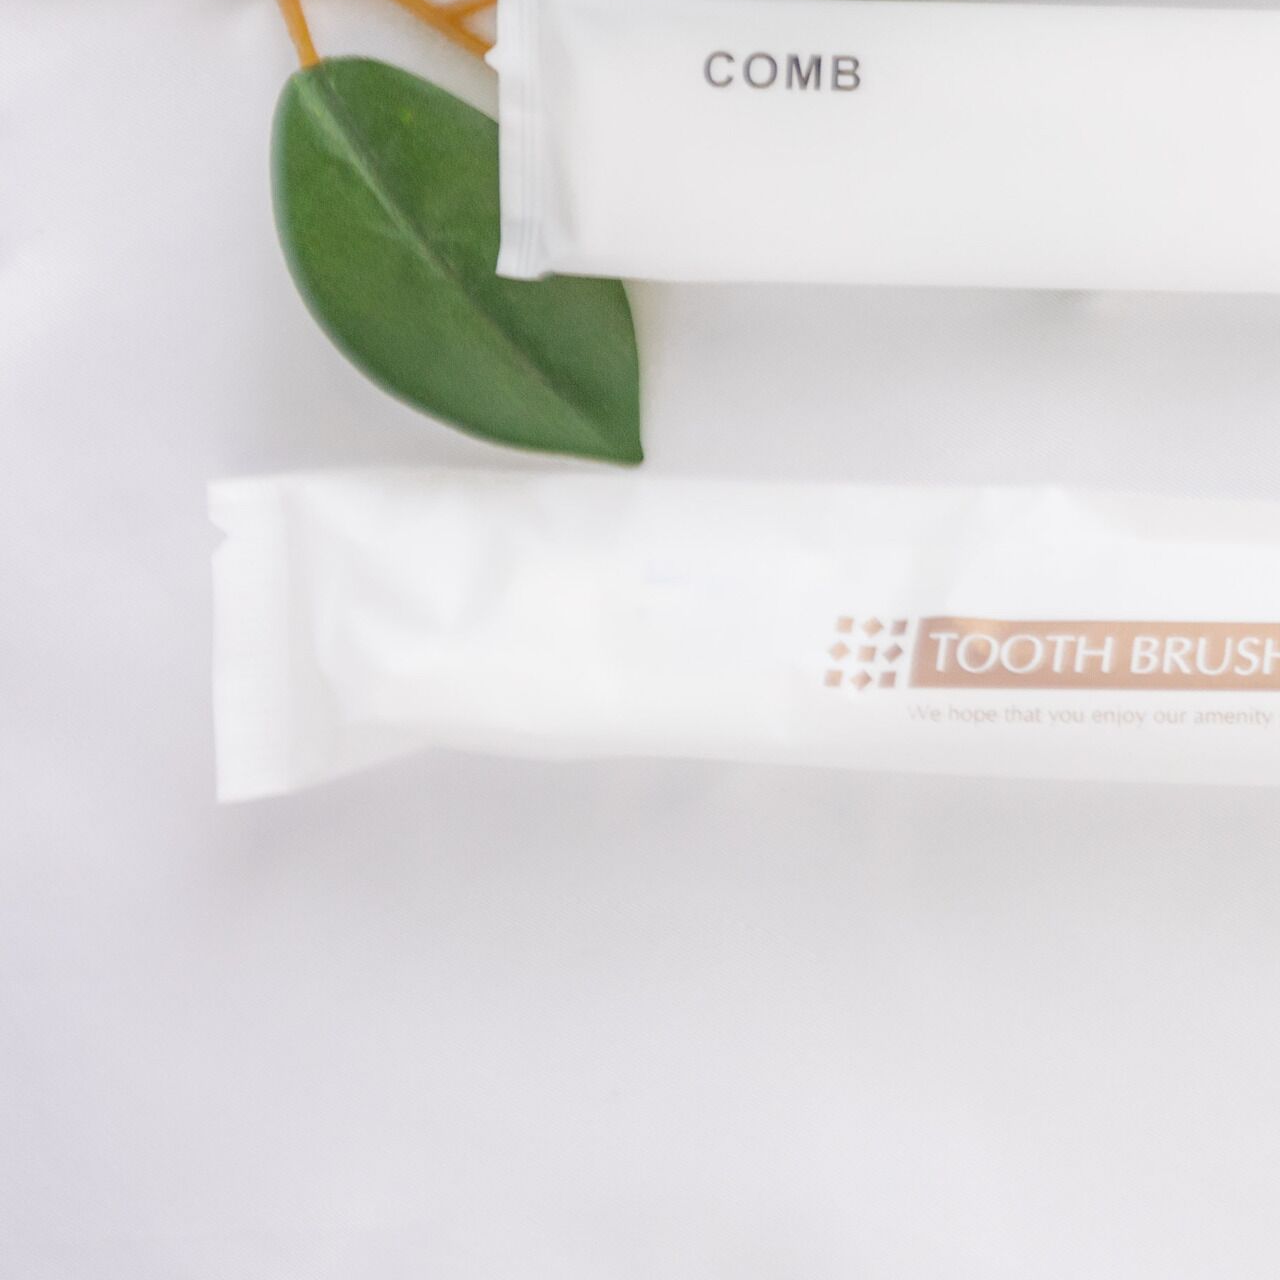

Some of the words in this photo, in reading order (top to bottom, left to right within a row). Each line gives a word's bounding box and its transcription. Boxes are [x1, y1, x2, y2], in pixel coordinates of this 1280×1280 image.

[702, 50, 862, 93] COMB
[929, 631, 1116, 674] TOOTH
[908, 703, 942, 722] We
[948, 703, 998, 727] hope
[1004, 704, 1042, 724] that
[1047, 708, 1085, 729] you
[1091, 706, 1145, 729] enjoy
[1152, 709, 1187, 725] our
[1192, 706, 1273, 729] amenity
